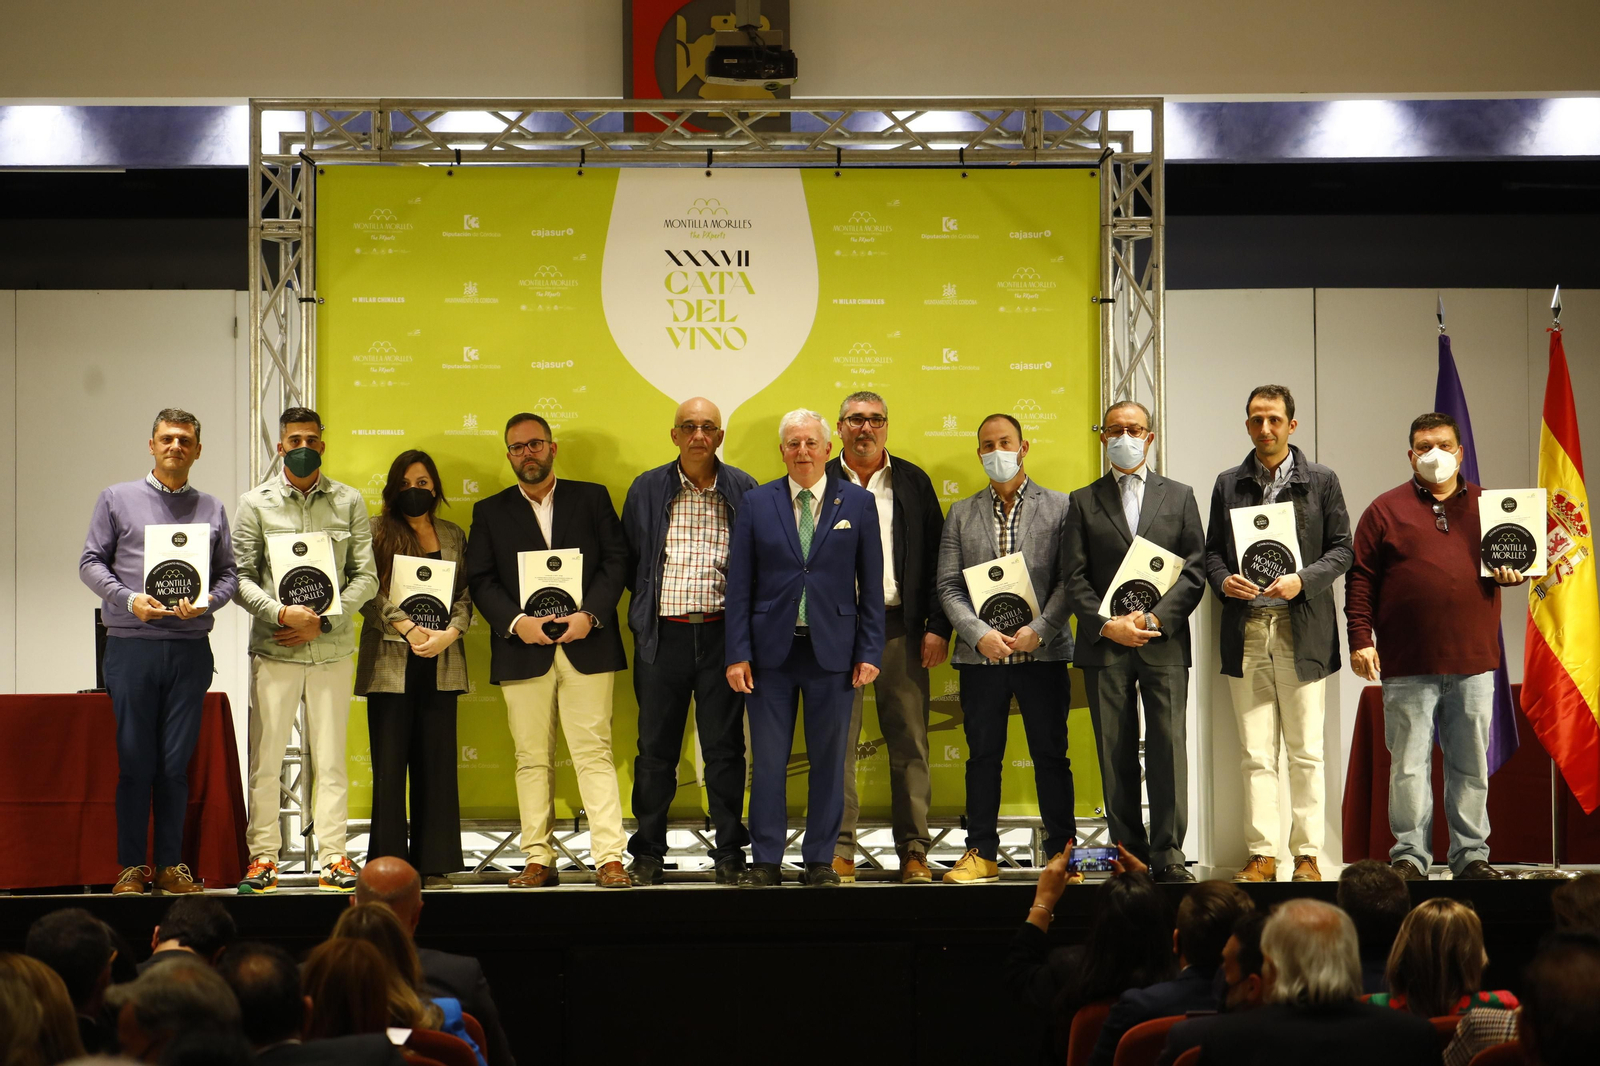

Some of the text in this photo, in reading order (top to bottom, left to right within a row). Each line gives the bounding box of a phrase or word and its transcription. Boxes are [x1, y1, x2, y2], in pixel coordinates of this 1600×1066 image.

[664, 219, 708, 228] MONTILLA
[531, 228, 565, 238] cajasur
[1009, 230, 1043, 240] cajasur
[664, 250, 750, 266] XXXVII
[664, 271, 756, 294] CATA
[666, 299, 738, 322] DEL
[665, 326, 747, 350] VINO
[531, 360, 565, 370] cajasur
[1010, 361, 1043, 372] cajasur
[1253, 554, 1286, 574] MONTILLA
[155, 579, 192, 588] MONTILLA
[289, 582, 323, 597] MONTILLA
[534, 605, 568, 617] MONTILLA
[989, 608, 1022, 625] MONTILLA
[410, 614, 440, 622] ONTILLA
[1012, 759, 1034, 768] cajas
